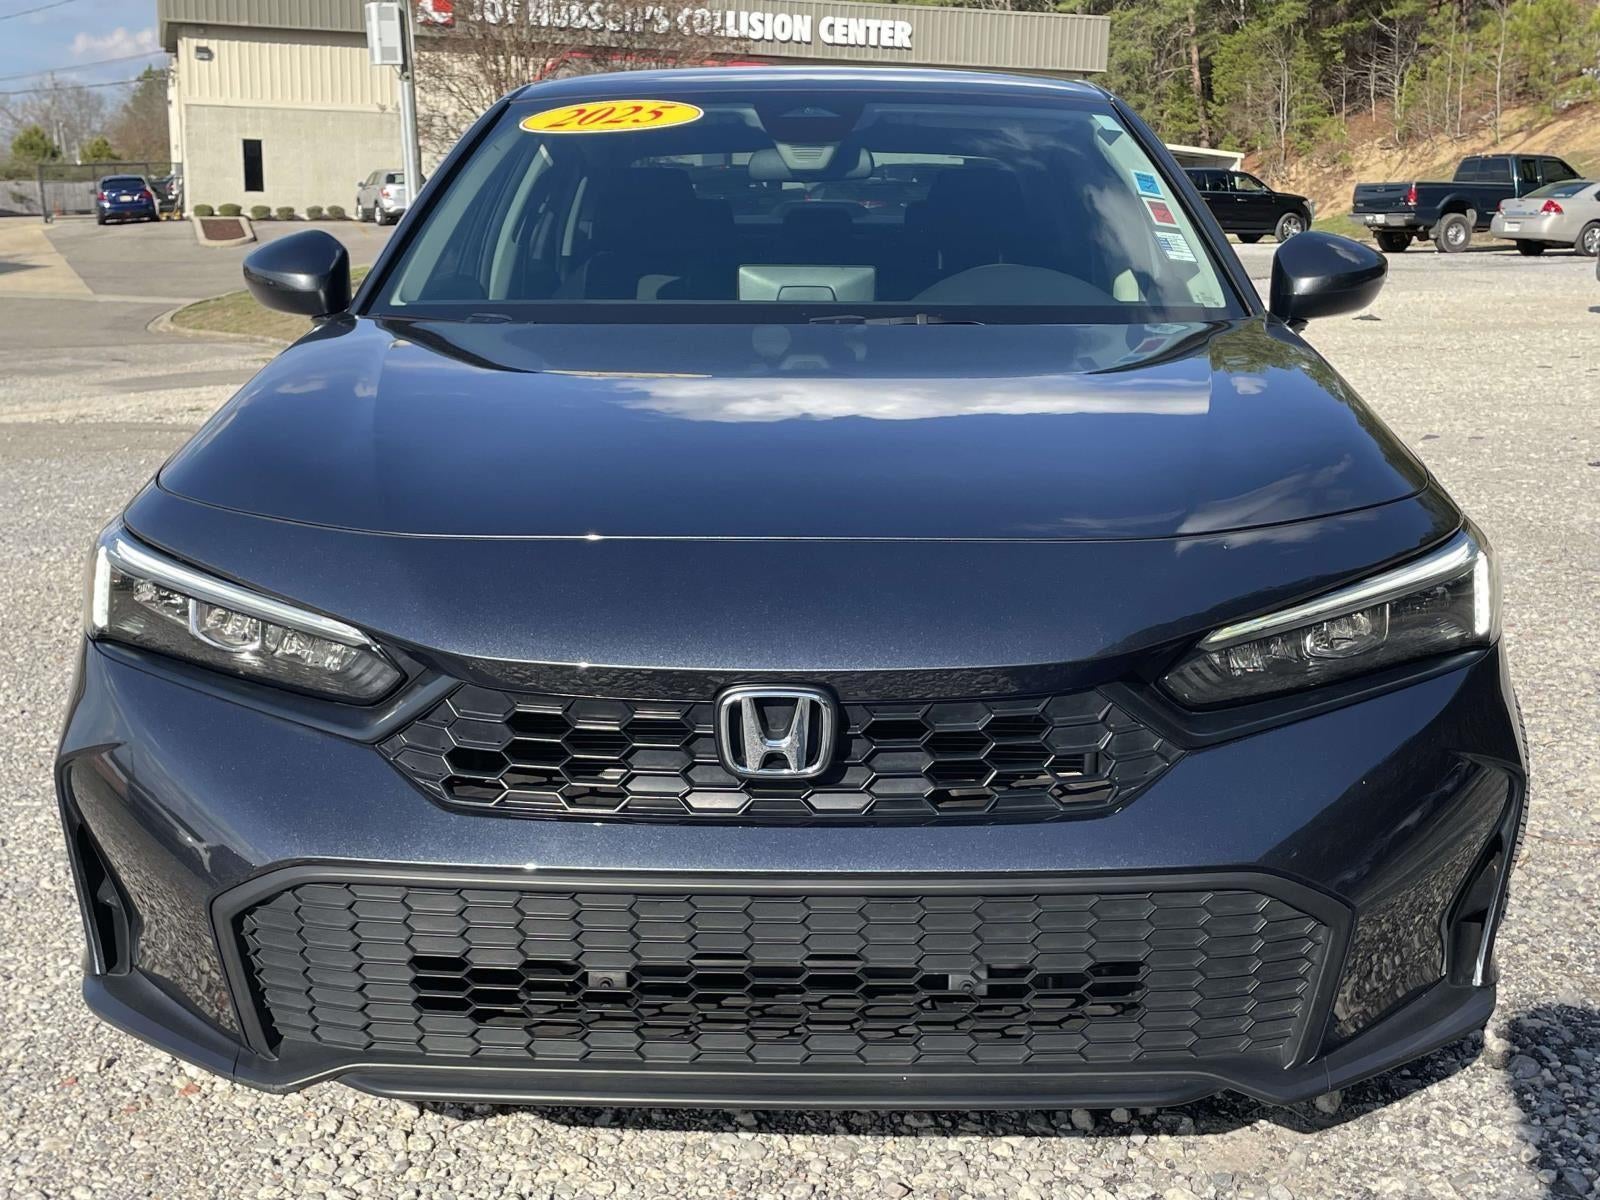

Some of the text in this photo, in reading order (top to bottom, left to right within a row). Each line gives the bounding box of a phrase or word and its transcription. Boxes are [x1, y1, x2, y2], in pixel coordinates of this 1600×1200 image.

[677, 8, 812, 43] COLLISION
[818, 16, 913, 48] CENTER
[544, 105, 676, 128] 2025
